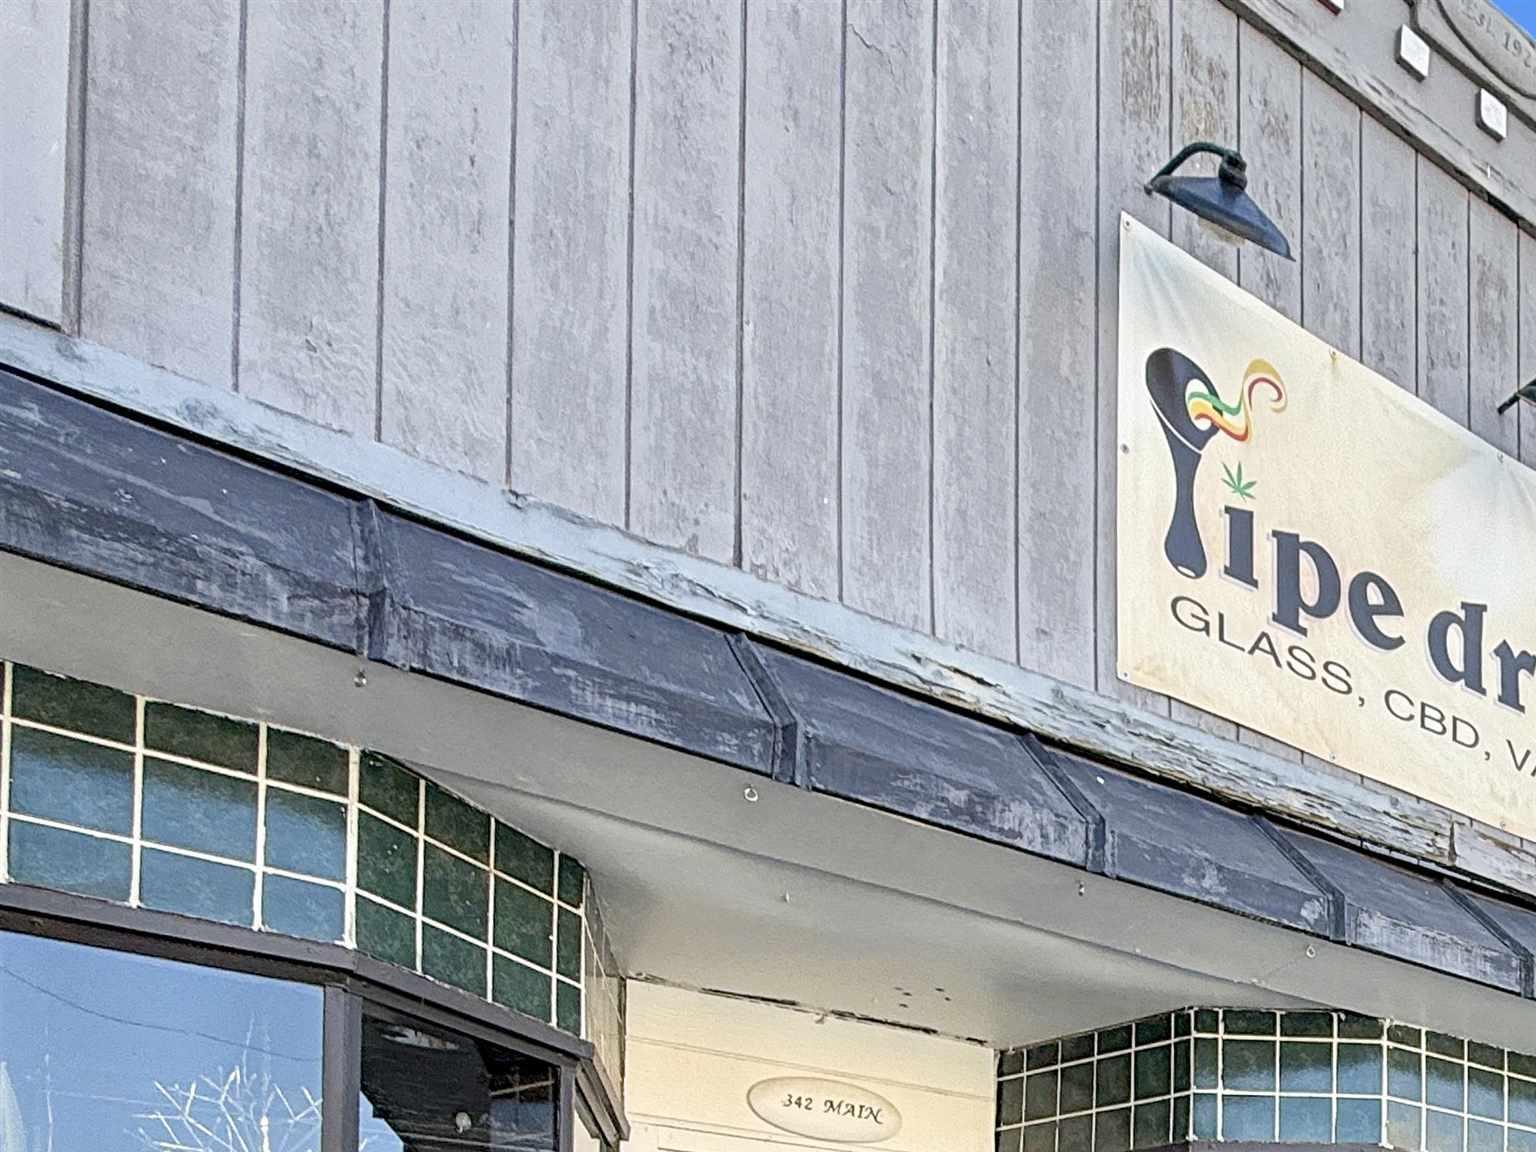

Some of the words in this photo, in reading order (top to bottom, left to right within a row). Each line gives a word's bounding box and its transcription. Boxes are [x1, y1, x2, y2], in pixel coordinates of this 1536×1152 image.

[1169, 594, 1368, 708] GLASS,
[1383, 687, 1492, 762] CBD,
[783, 1093, 814, 1111] 342
[823, 1099, 884, 1125] MAIN
